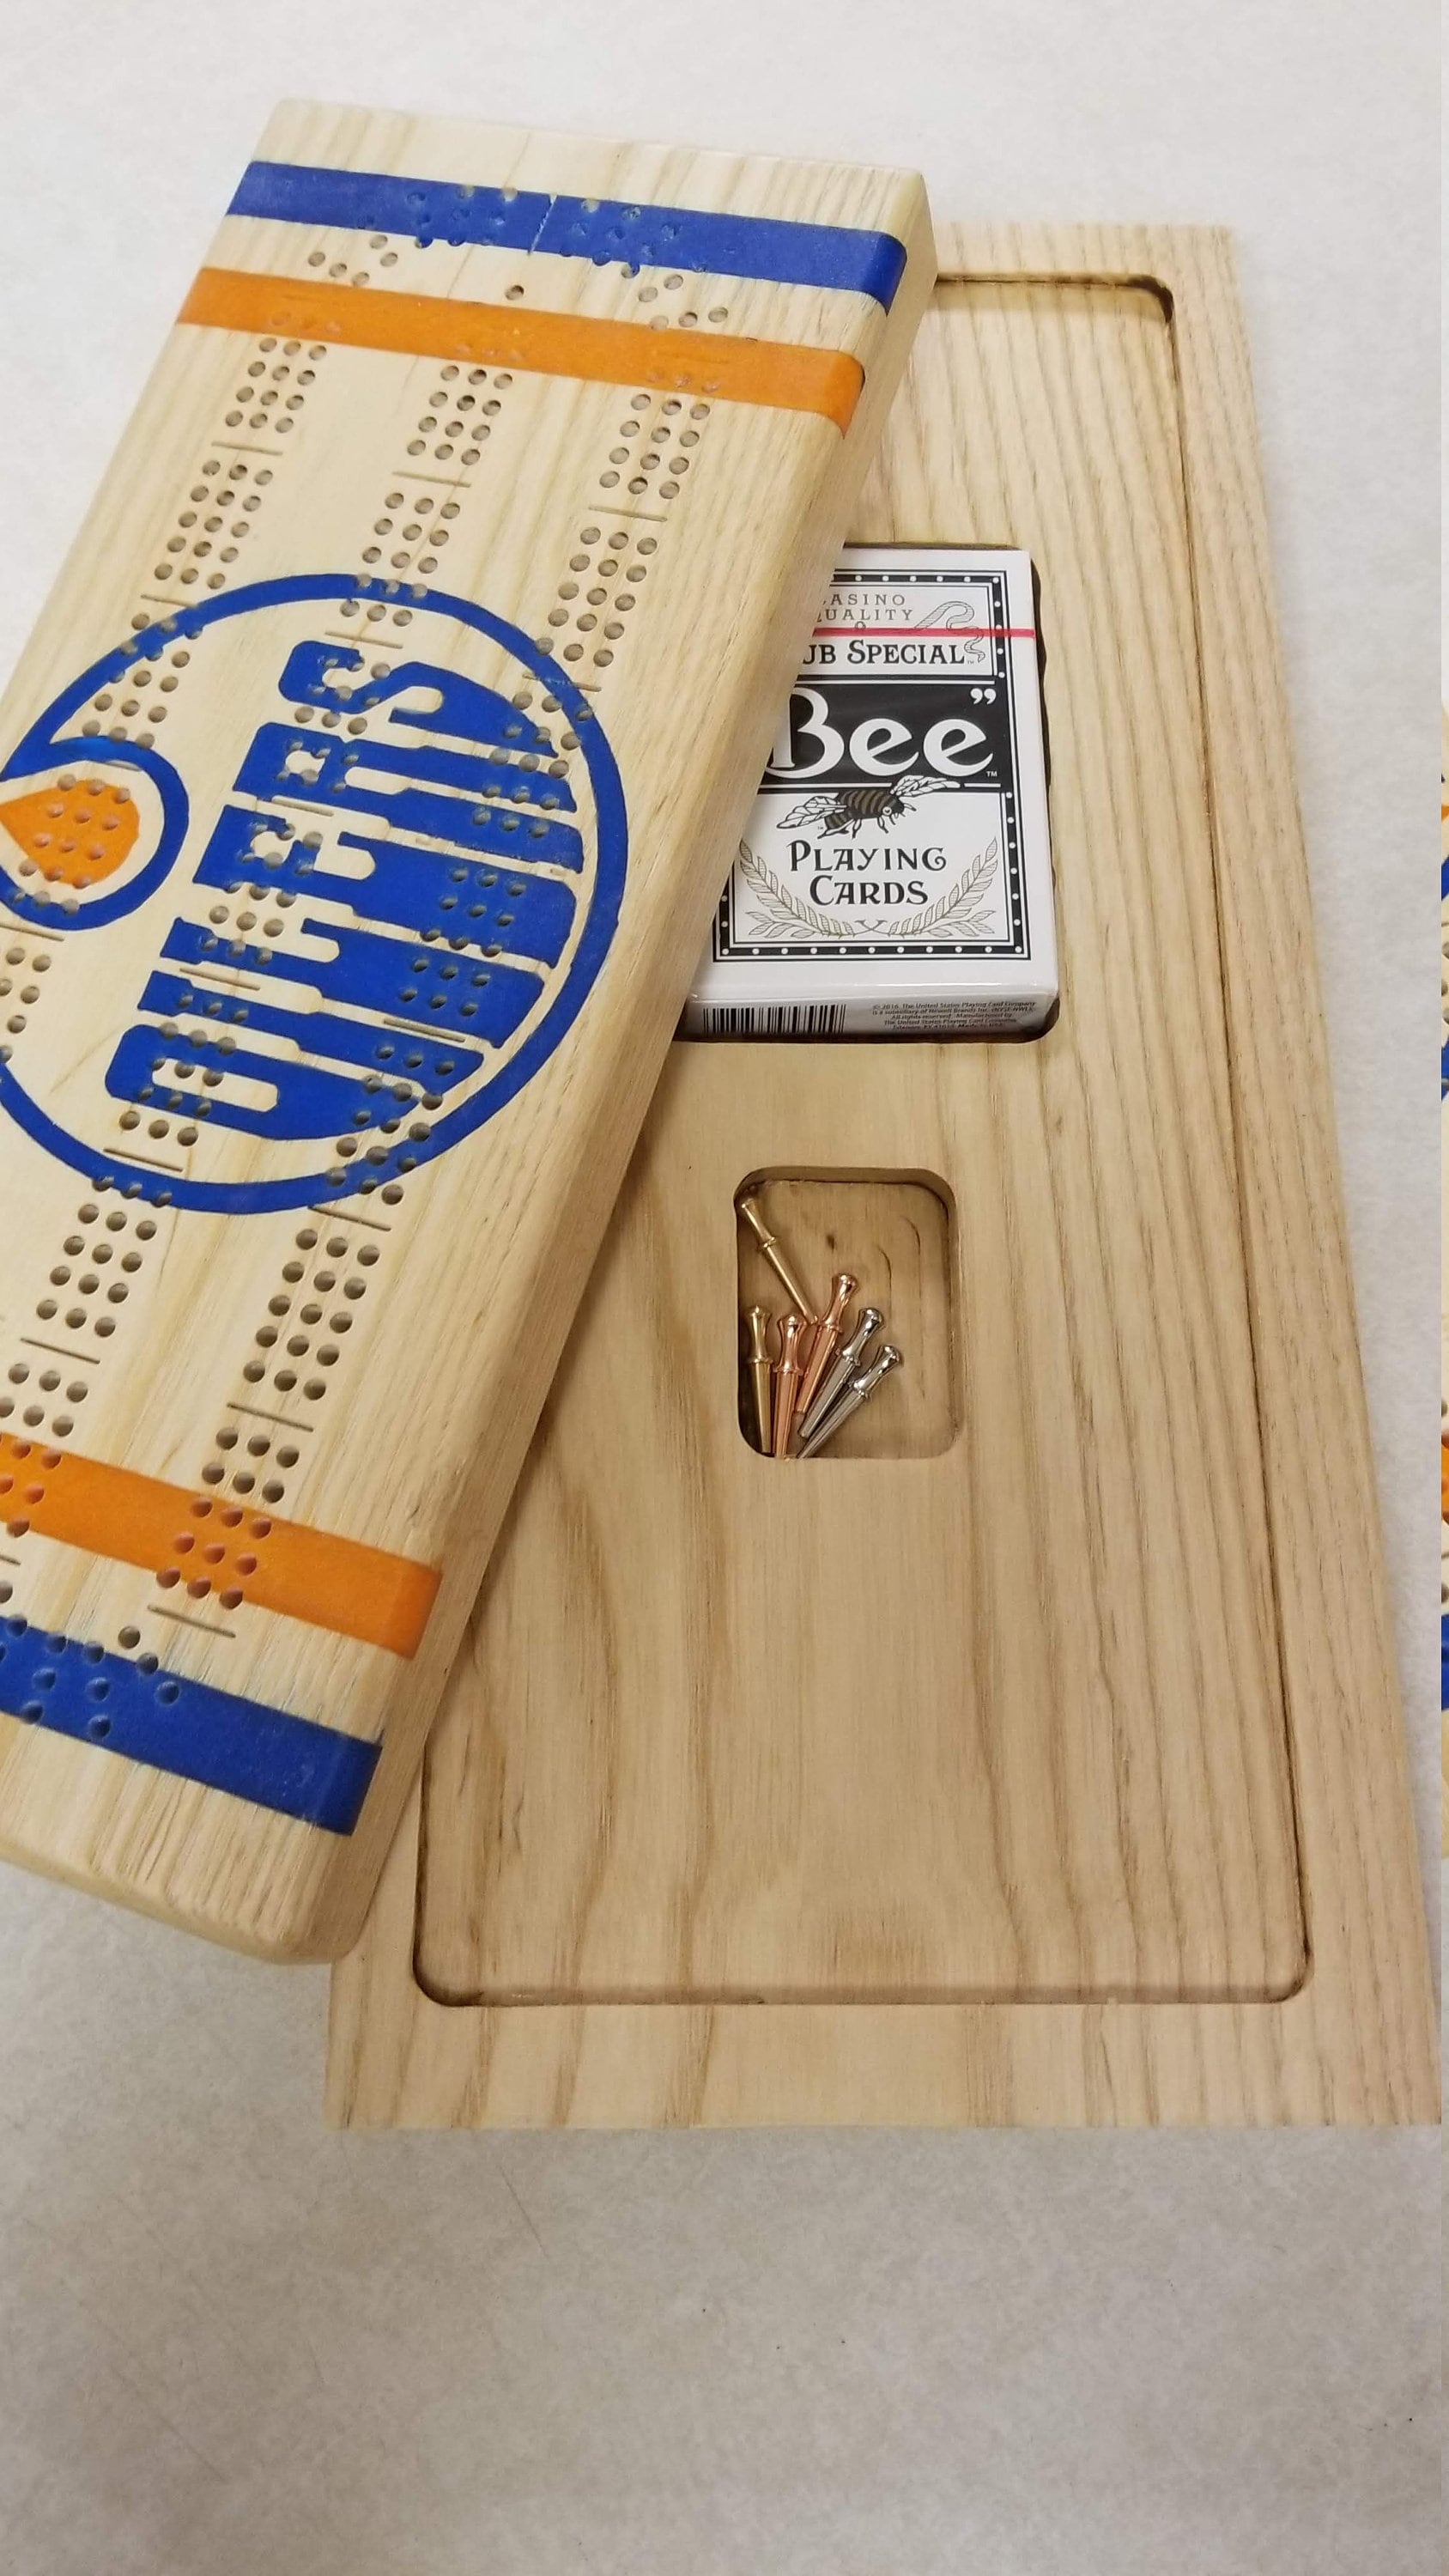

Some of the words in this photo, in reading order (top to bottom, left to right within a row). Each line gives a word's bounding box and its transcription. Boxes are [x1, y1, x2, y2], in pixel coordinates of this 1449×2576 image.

[823, 593, 906, 606] ASINO
[817, 609, 913, 623] UALITY
[104, 640, 585, 1140] OILERS
[809, 874, 929, 905] CARDS
